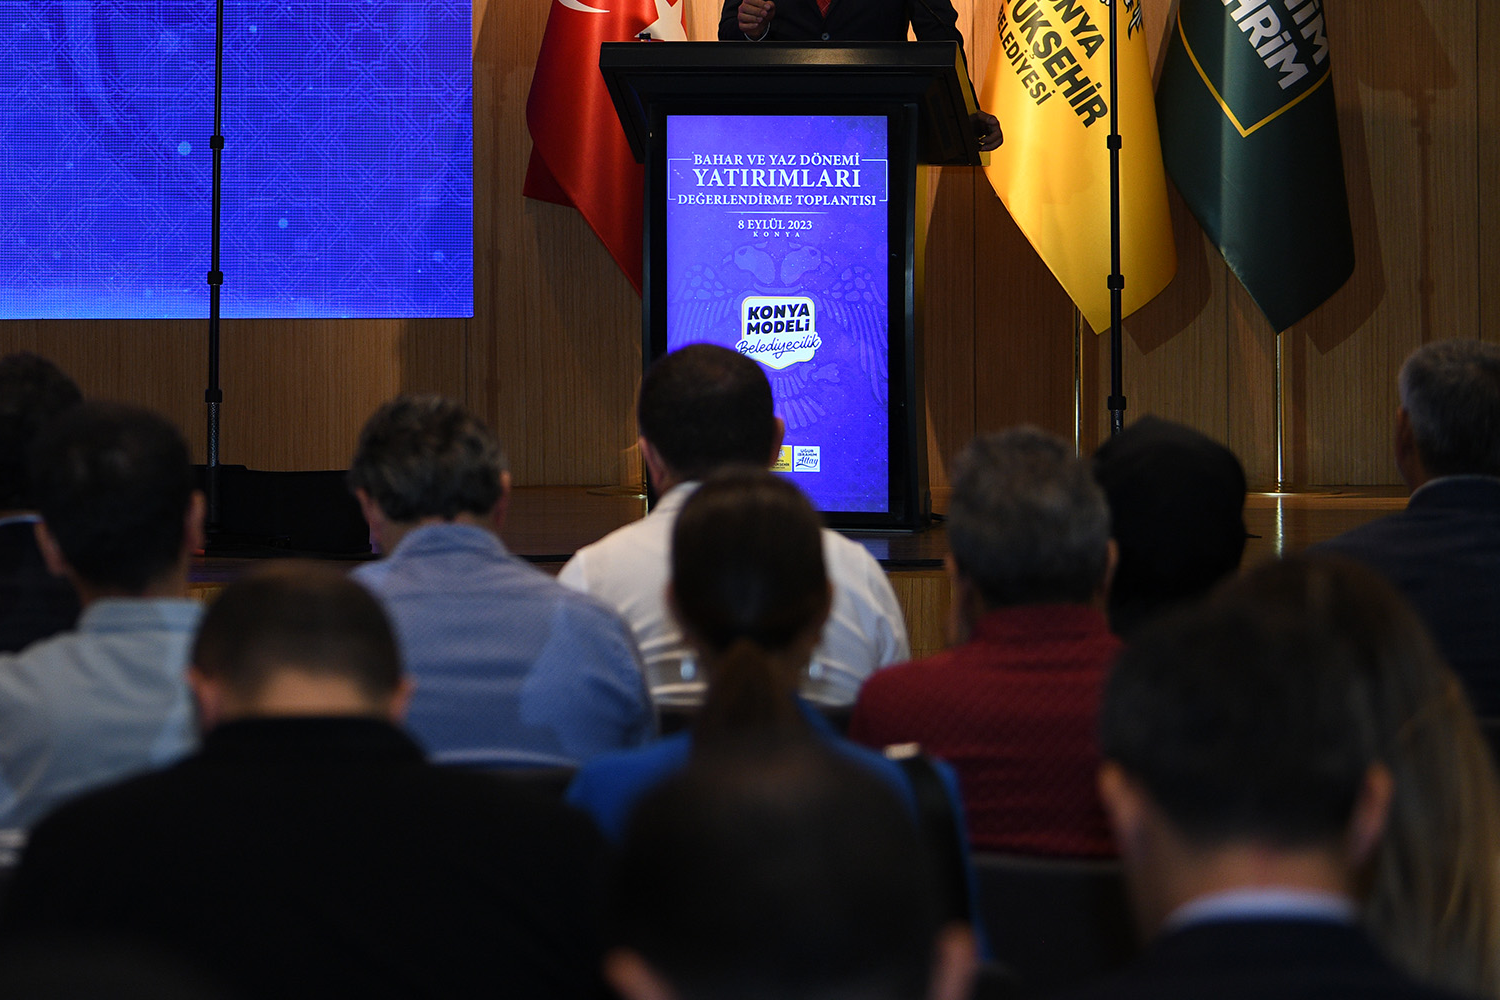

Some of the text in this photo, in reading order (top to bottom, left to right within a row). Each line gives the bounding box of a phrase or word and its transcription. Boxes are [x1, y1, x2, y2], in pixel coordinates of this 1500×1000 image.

[693, 152, 860, 166] BAHAR VE YAZ DÖNEMİ
[692, 168, 861, 188] YATIRIMLARI
[678, 192, 877, 206] DEĞERLENDİRME TOPLANTISI
[737, 217, 813, 230] 8 EYLÜL 2023
[748, 303, 810, 321] KONYA
[746, 318, 810, 336] MODELİ
[736, 334, 820, 359] Belediyecilik
